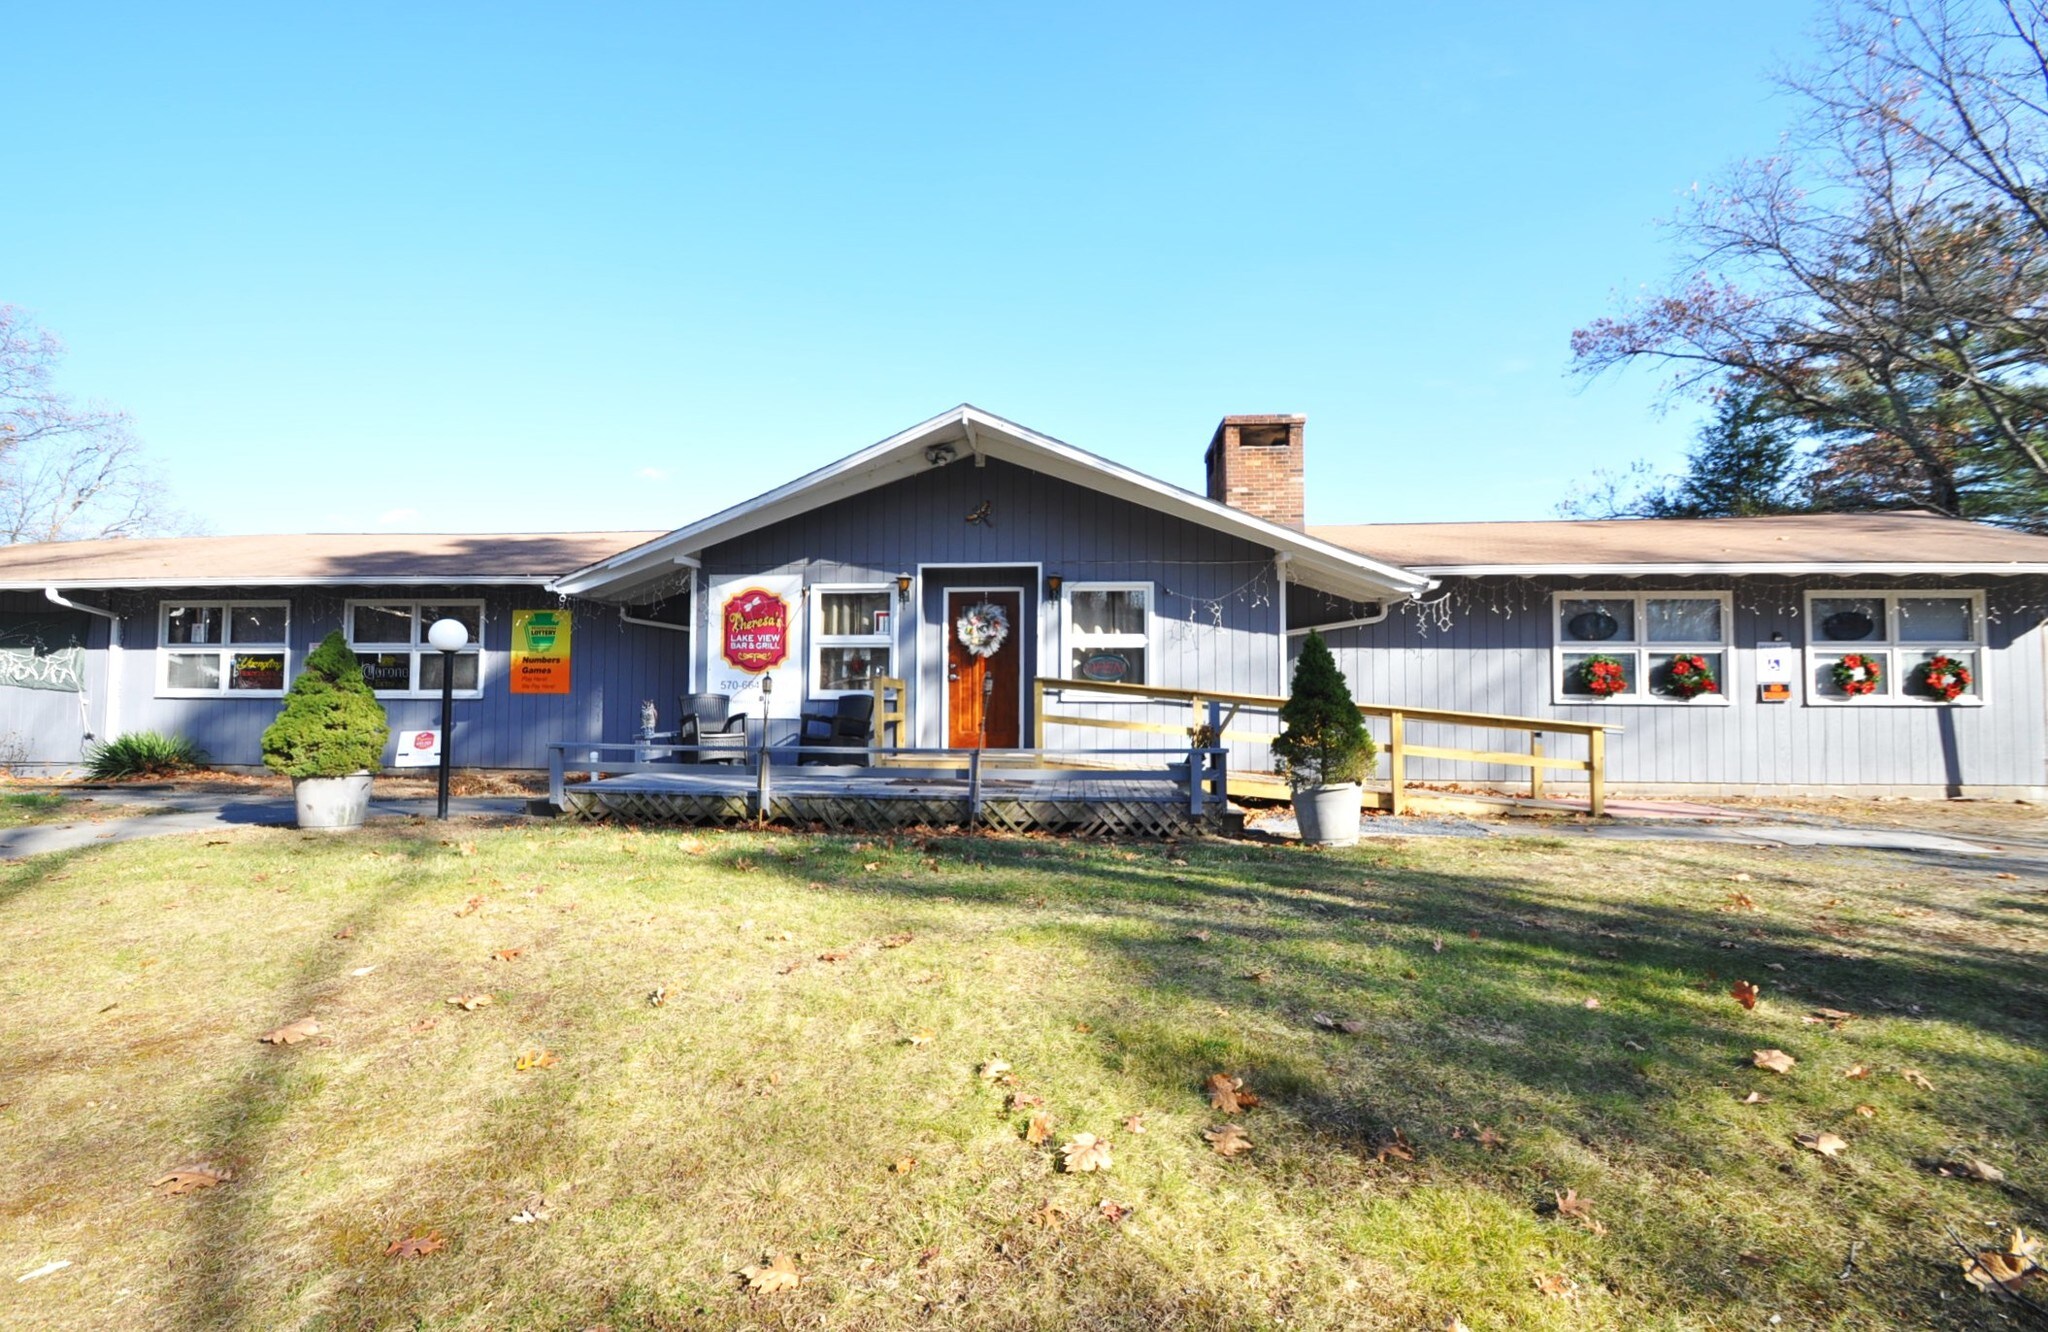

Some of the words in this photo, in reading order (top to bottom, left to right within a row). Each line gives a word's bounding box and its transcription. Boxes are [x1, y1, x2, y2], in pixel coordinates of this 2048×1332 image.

[729, 611, 782, 633] Theresa's
[730, 634, 754, 642] LAKE
[757, 634, 780, 642] VIEW
[522, 656, 561, 664] Numbers
[362, 662, 409, 680] Corona
